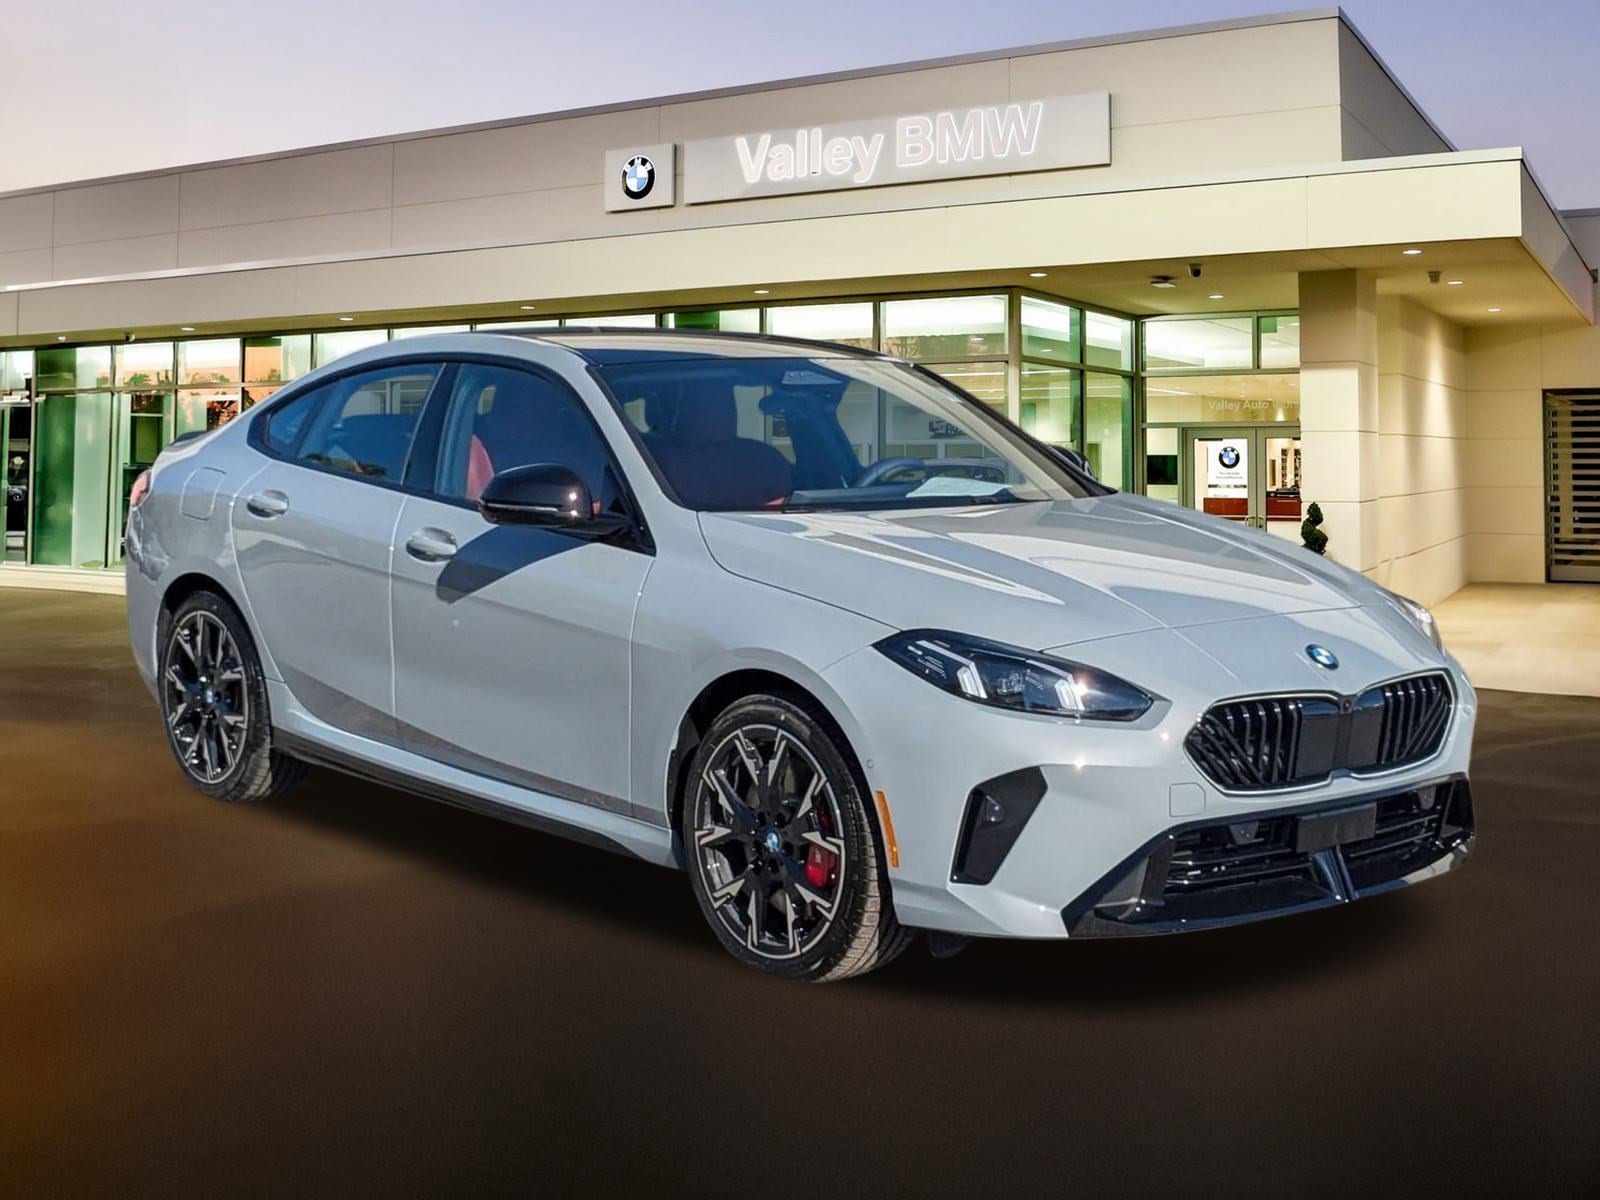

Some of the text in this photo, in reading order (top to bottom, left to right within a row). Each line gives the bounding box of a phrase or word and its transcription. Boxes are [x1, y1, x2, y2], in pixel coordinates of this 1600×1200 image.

[735, 102, 1043, 183] Valley BMW
[1208, 400, 1240, 412] Valley
[1243, 400, 1269, 410] Auto
